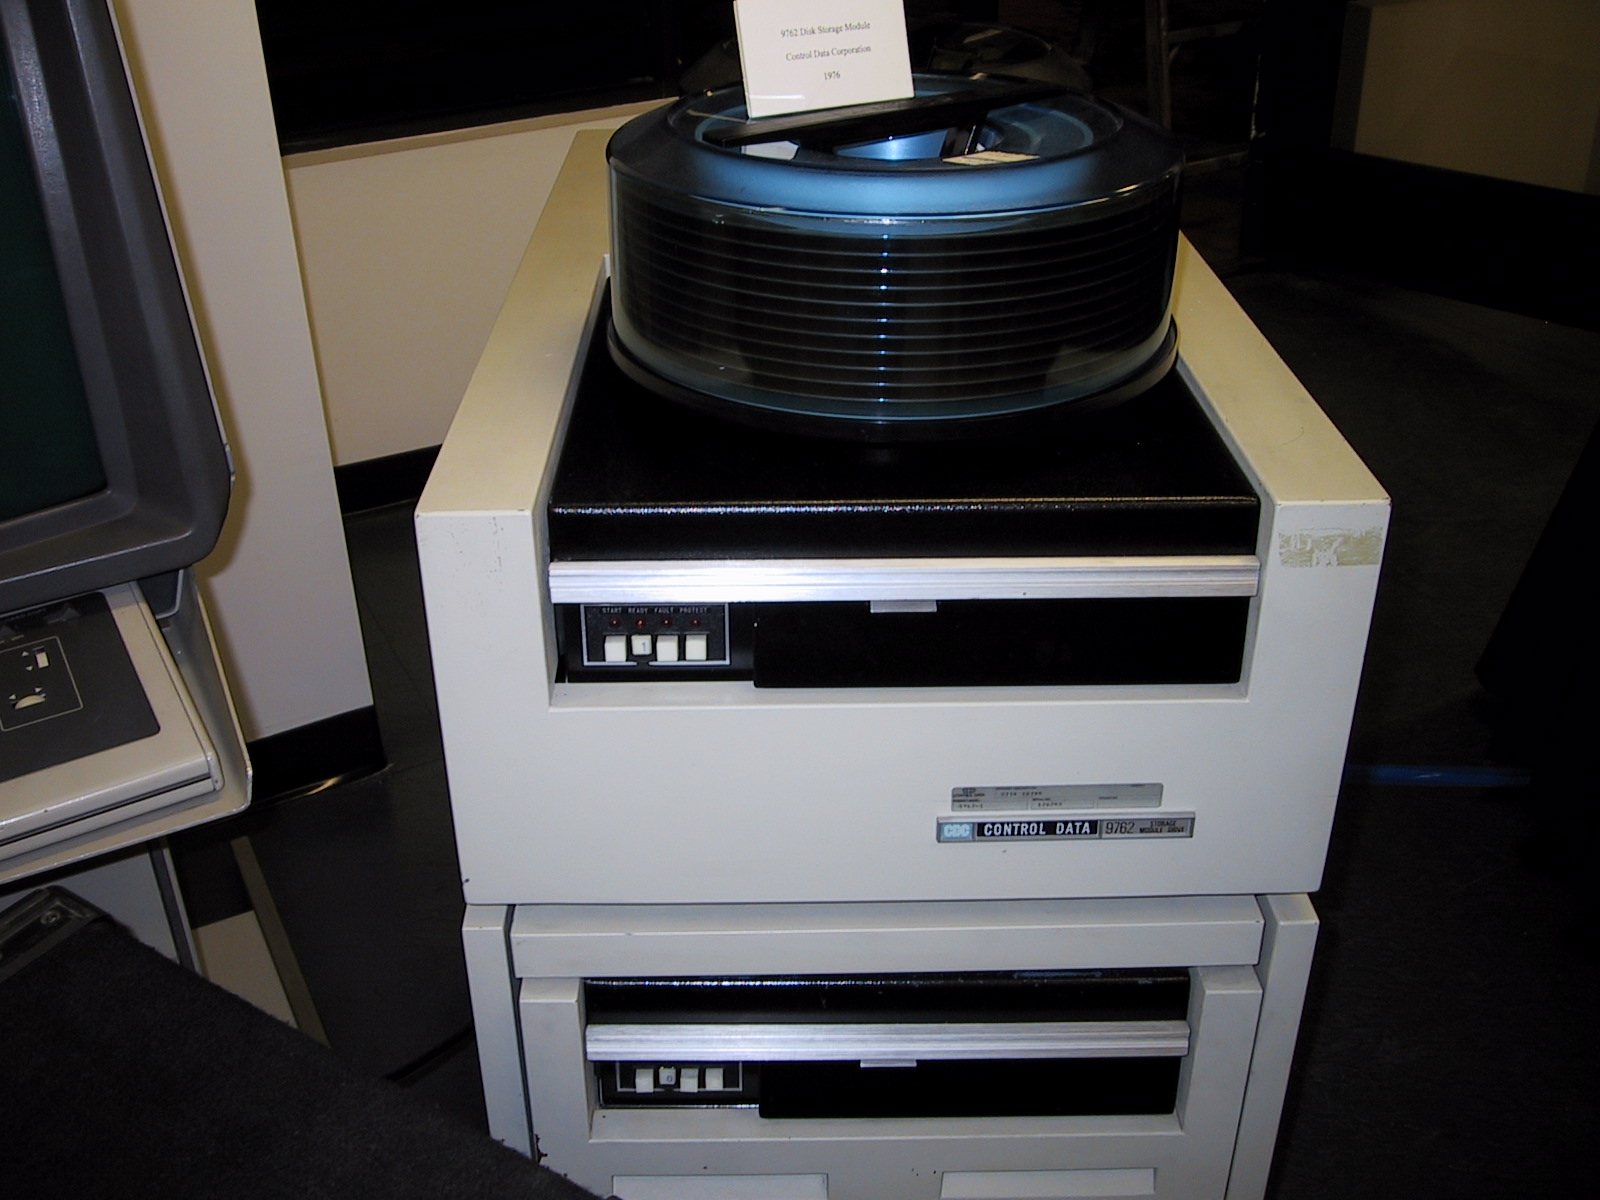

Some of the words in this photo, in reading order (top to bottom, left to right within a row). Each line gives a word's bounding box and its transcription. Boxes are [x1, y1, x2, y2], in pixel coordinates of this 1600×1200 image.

[780, 29, 798, 38] 9762
[800, 27, 816, 36] Disk
[817, 25, 843, 35] Storage
[844, 21, 871, 31] Module
[785, 51, 812, 61] Control
[814, 49, 830, 58] Data
[831, 44, 871, 56] Corporation
[823, 71, 841, 81] 1976
[679, 606, 708, 614] PROTECT
[943, 823, 970, 838] CDC
[983, 822, 1047, 836] CONTROL
[1055, 821, 1091, 835] DATA
[1105, 821, 1135, 834] 9762
